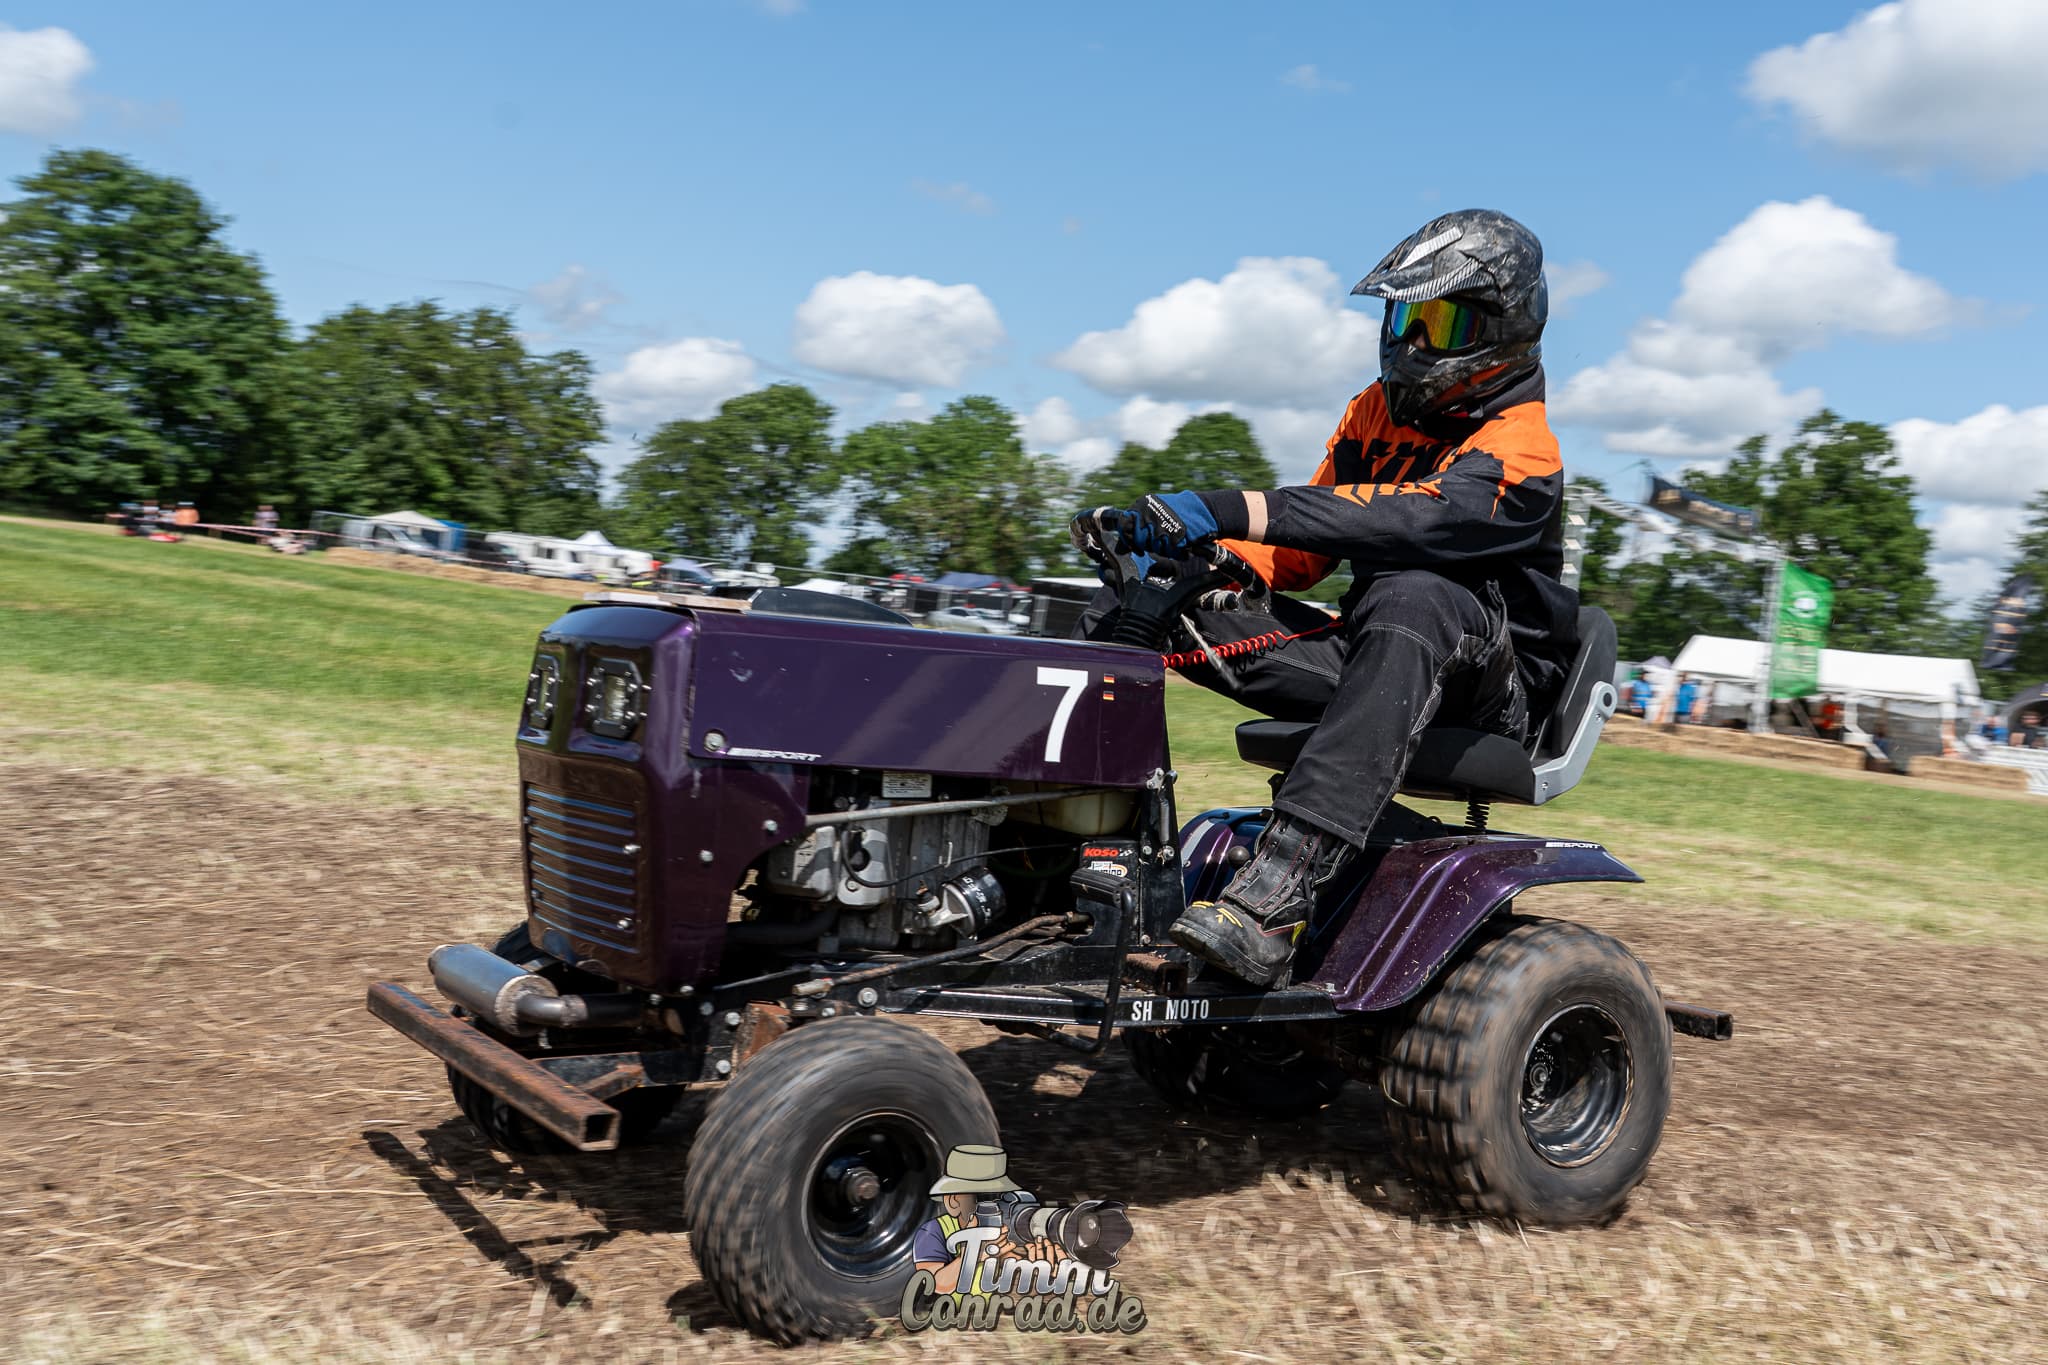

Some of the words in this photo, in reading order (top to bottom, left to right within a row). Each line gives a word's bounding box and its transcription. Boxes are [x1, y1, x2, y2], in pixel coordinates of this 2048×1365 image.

[1037, 666, 1088, 763] 7
[1083, 847, 1120, 858] KOSO
[1131, 1000, 1153, 1021] SH
[1165, 999, 1210, 1020] MOTO
